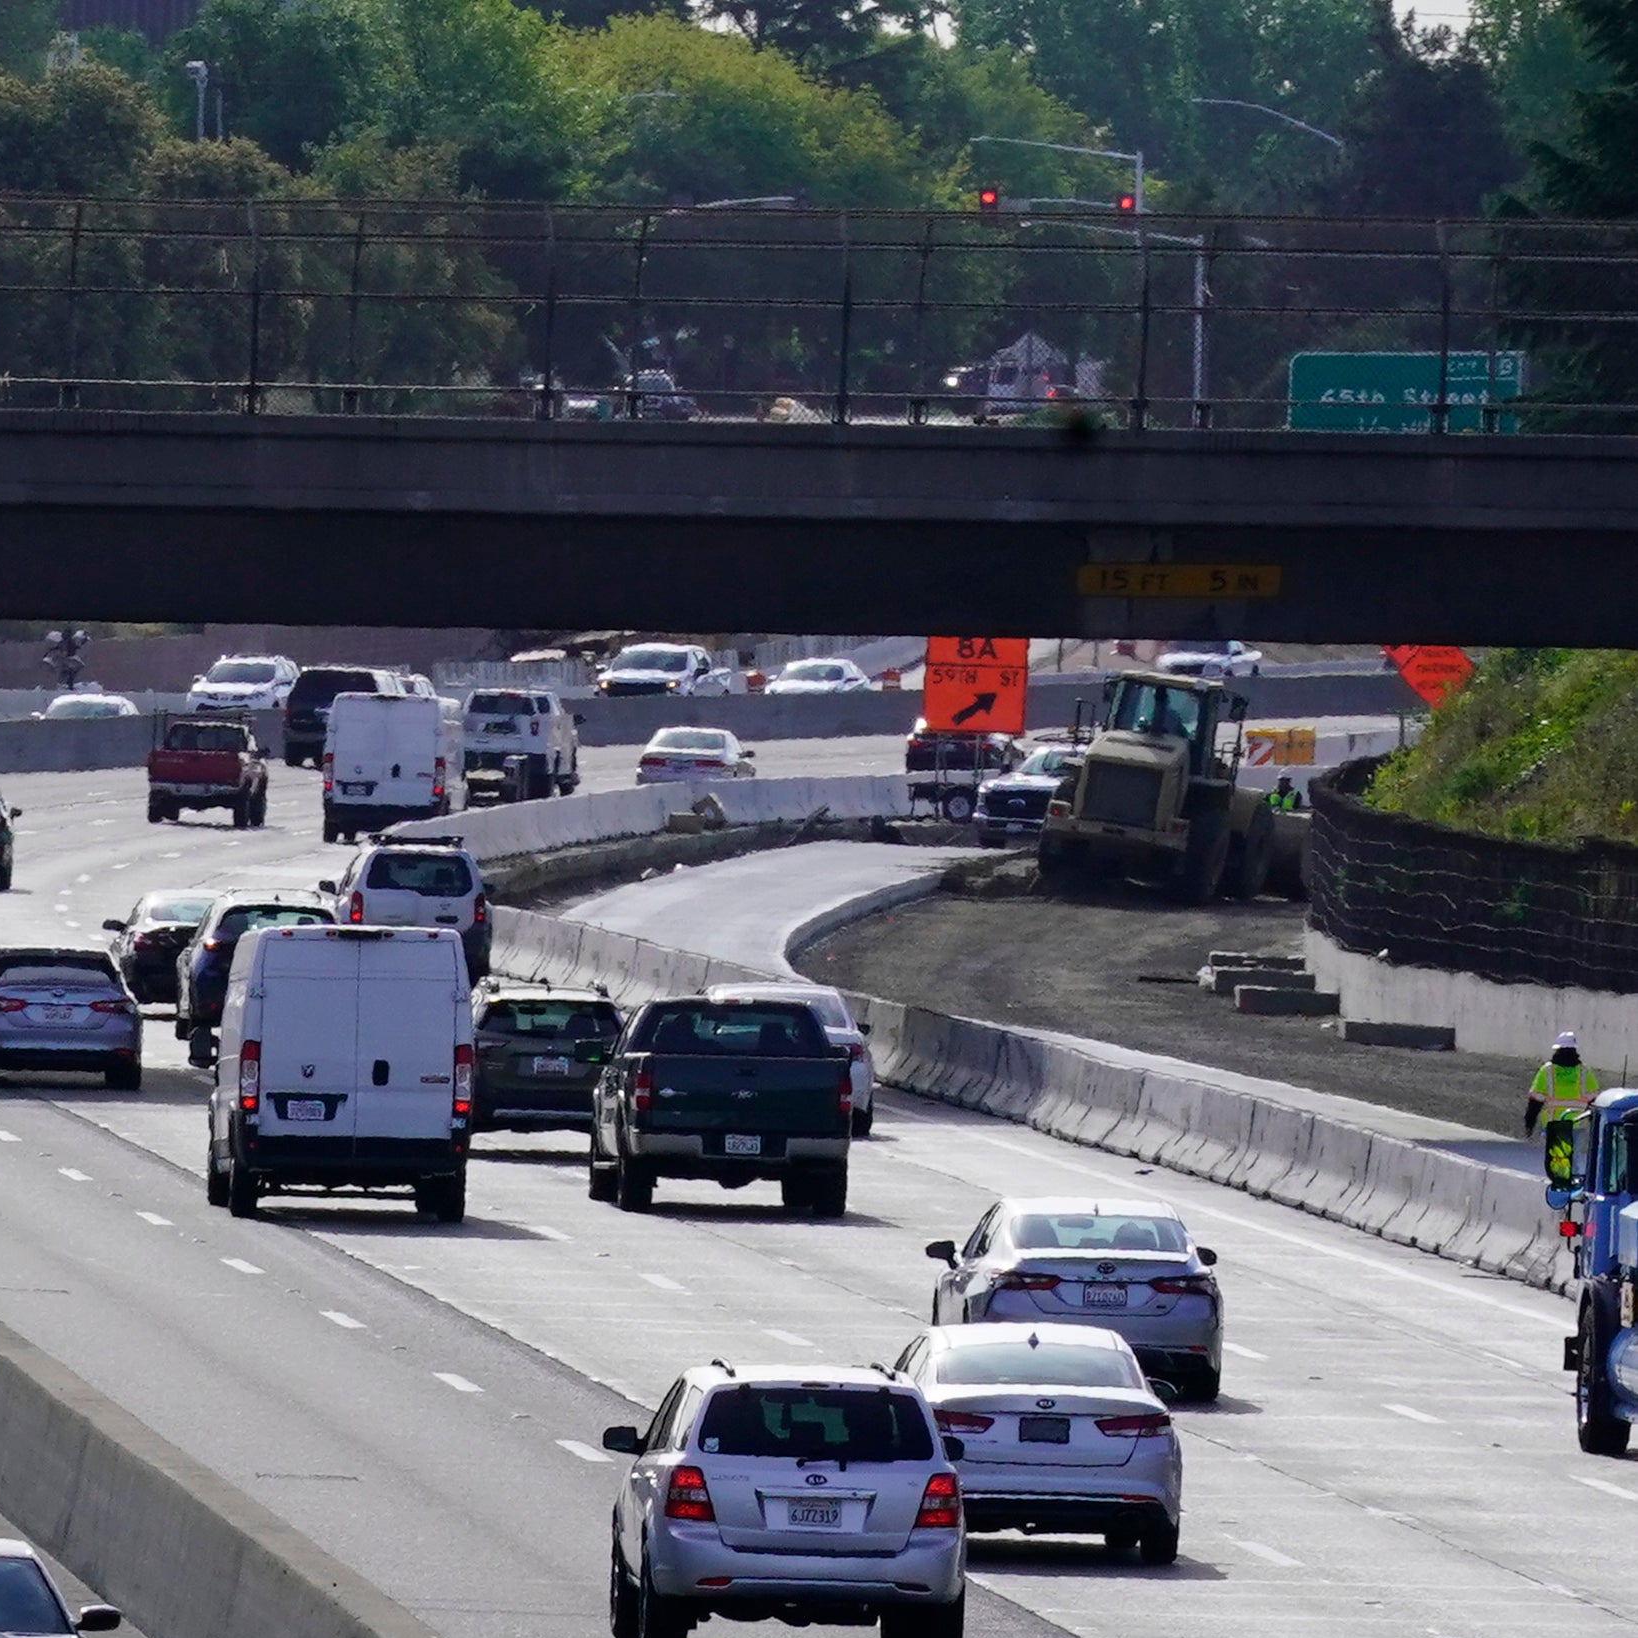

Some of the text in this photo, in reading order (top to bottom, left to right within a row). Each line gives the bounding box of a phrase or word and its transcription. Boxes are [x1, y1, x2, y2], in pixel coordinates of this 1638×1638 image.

[1101, 570, 1128, 590] 15
[1142, 574, 1169, 590] FT
[1210, 570, 1227, 591] 5
[957, 638, 998, 659] 8A
[932, 668, 977, 684] 59TH
